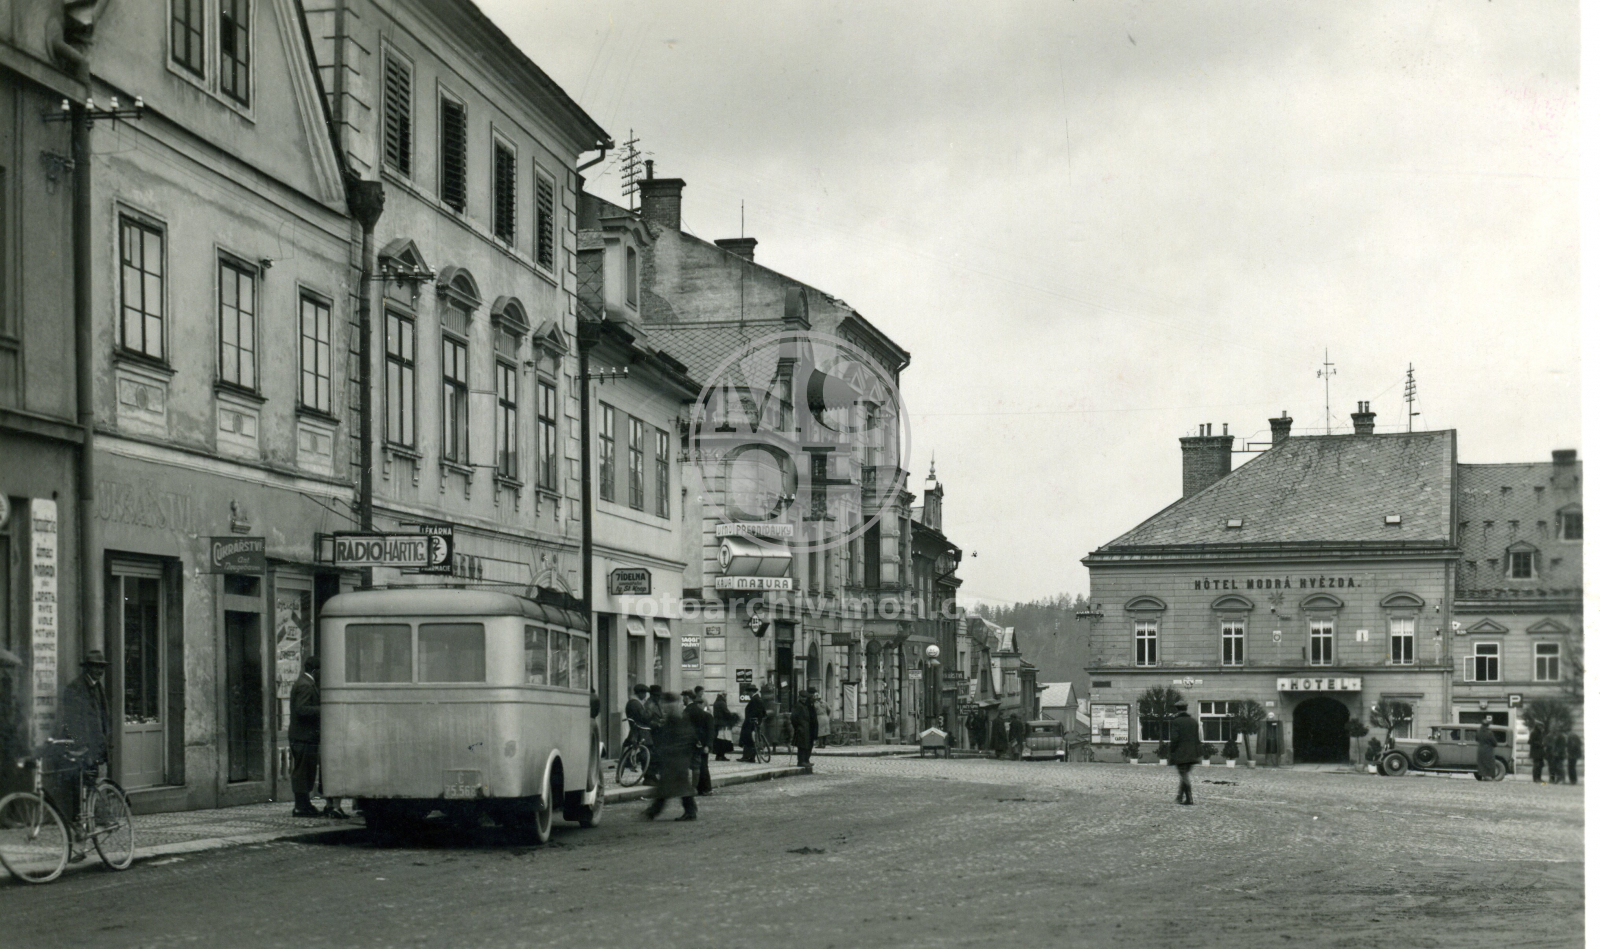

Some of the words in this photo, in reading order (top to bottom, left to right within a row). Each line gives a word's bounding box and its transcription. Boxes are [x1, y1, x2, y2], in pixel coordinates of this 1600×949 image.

[421, 525, 452, 536] LÉKÁRNA
[213, 539, 263, 566] CUKRÁŘSTVÍ
[336, 539, 383, 561] RADIO
[737, 578, 789, 589] MAZURA
[1246, 575, 1292, 589] MODRÁ
[1290, 679, 1348, 690] HOTEL
[1509, 694, 1521, 707] P
